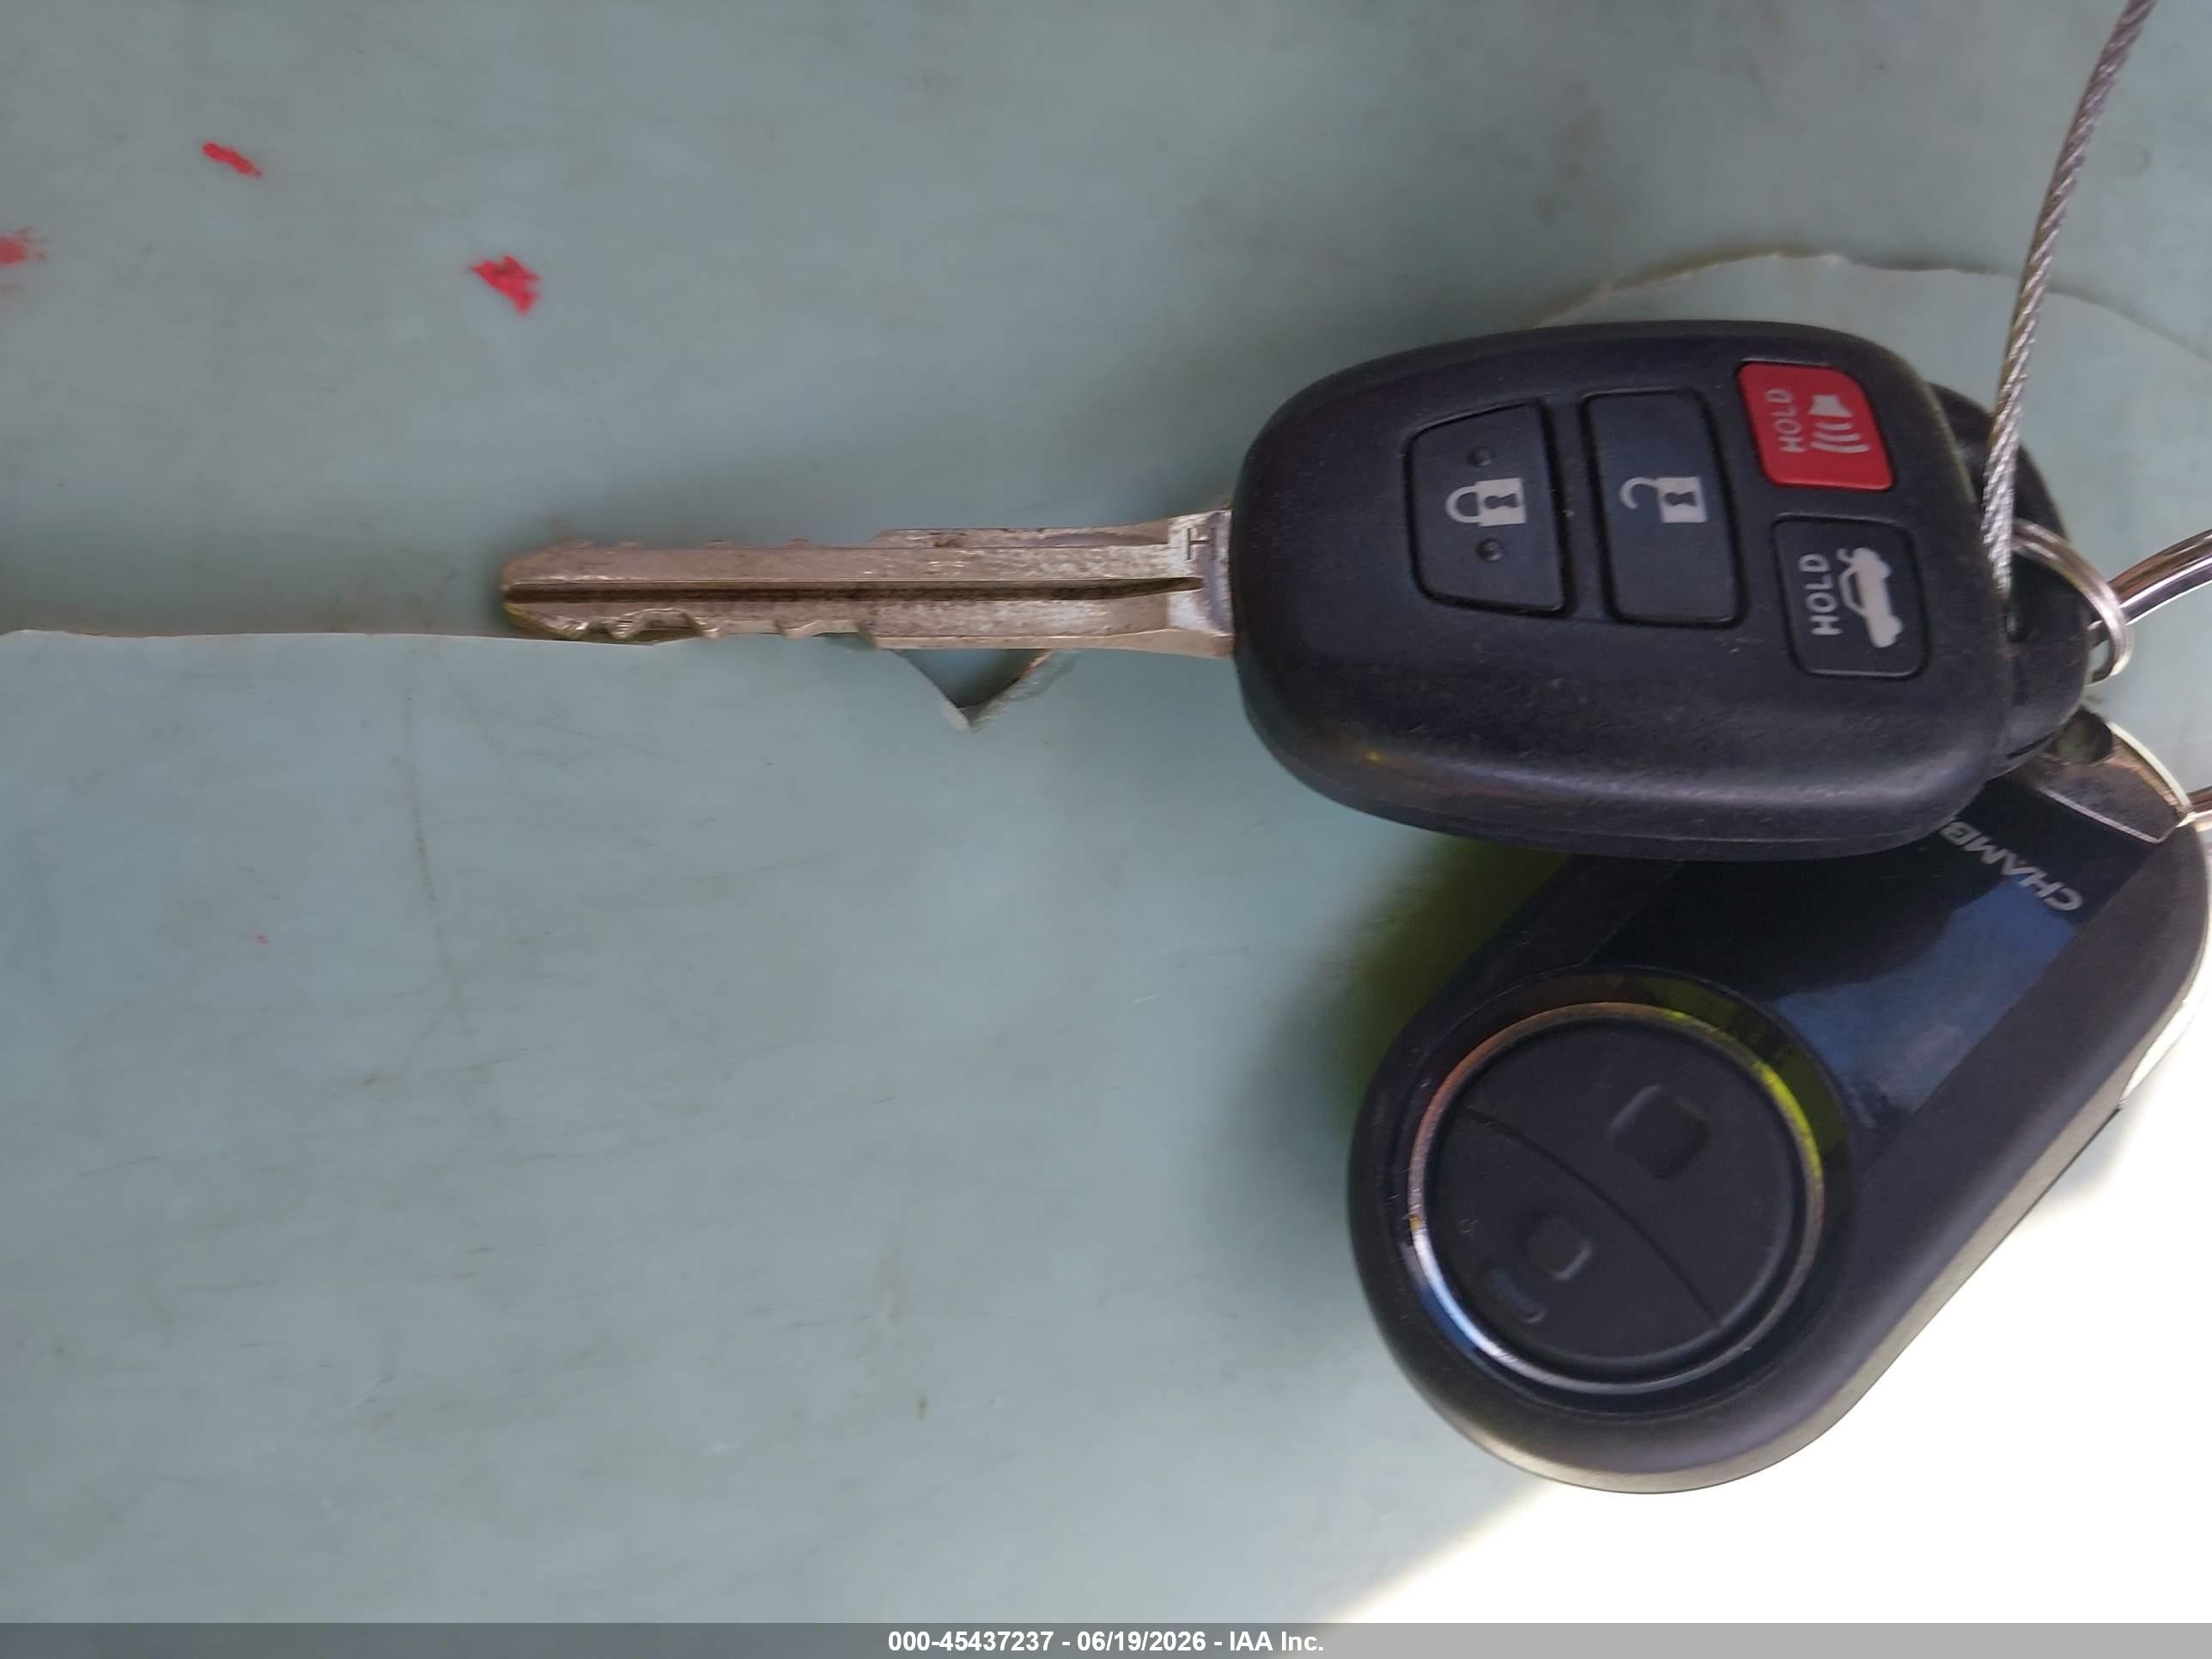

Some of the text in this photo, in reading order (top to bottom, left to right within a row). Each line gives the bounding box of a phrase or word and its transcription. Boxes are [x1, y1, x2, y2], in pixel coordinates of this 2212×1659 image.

[1765, 389, 1807, 453] HOLD
[1186, 527, 1217, 561] H
[1798, 553, 1843, 637] HOLD
